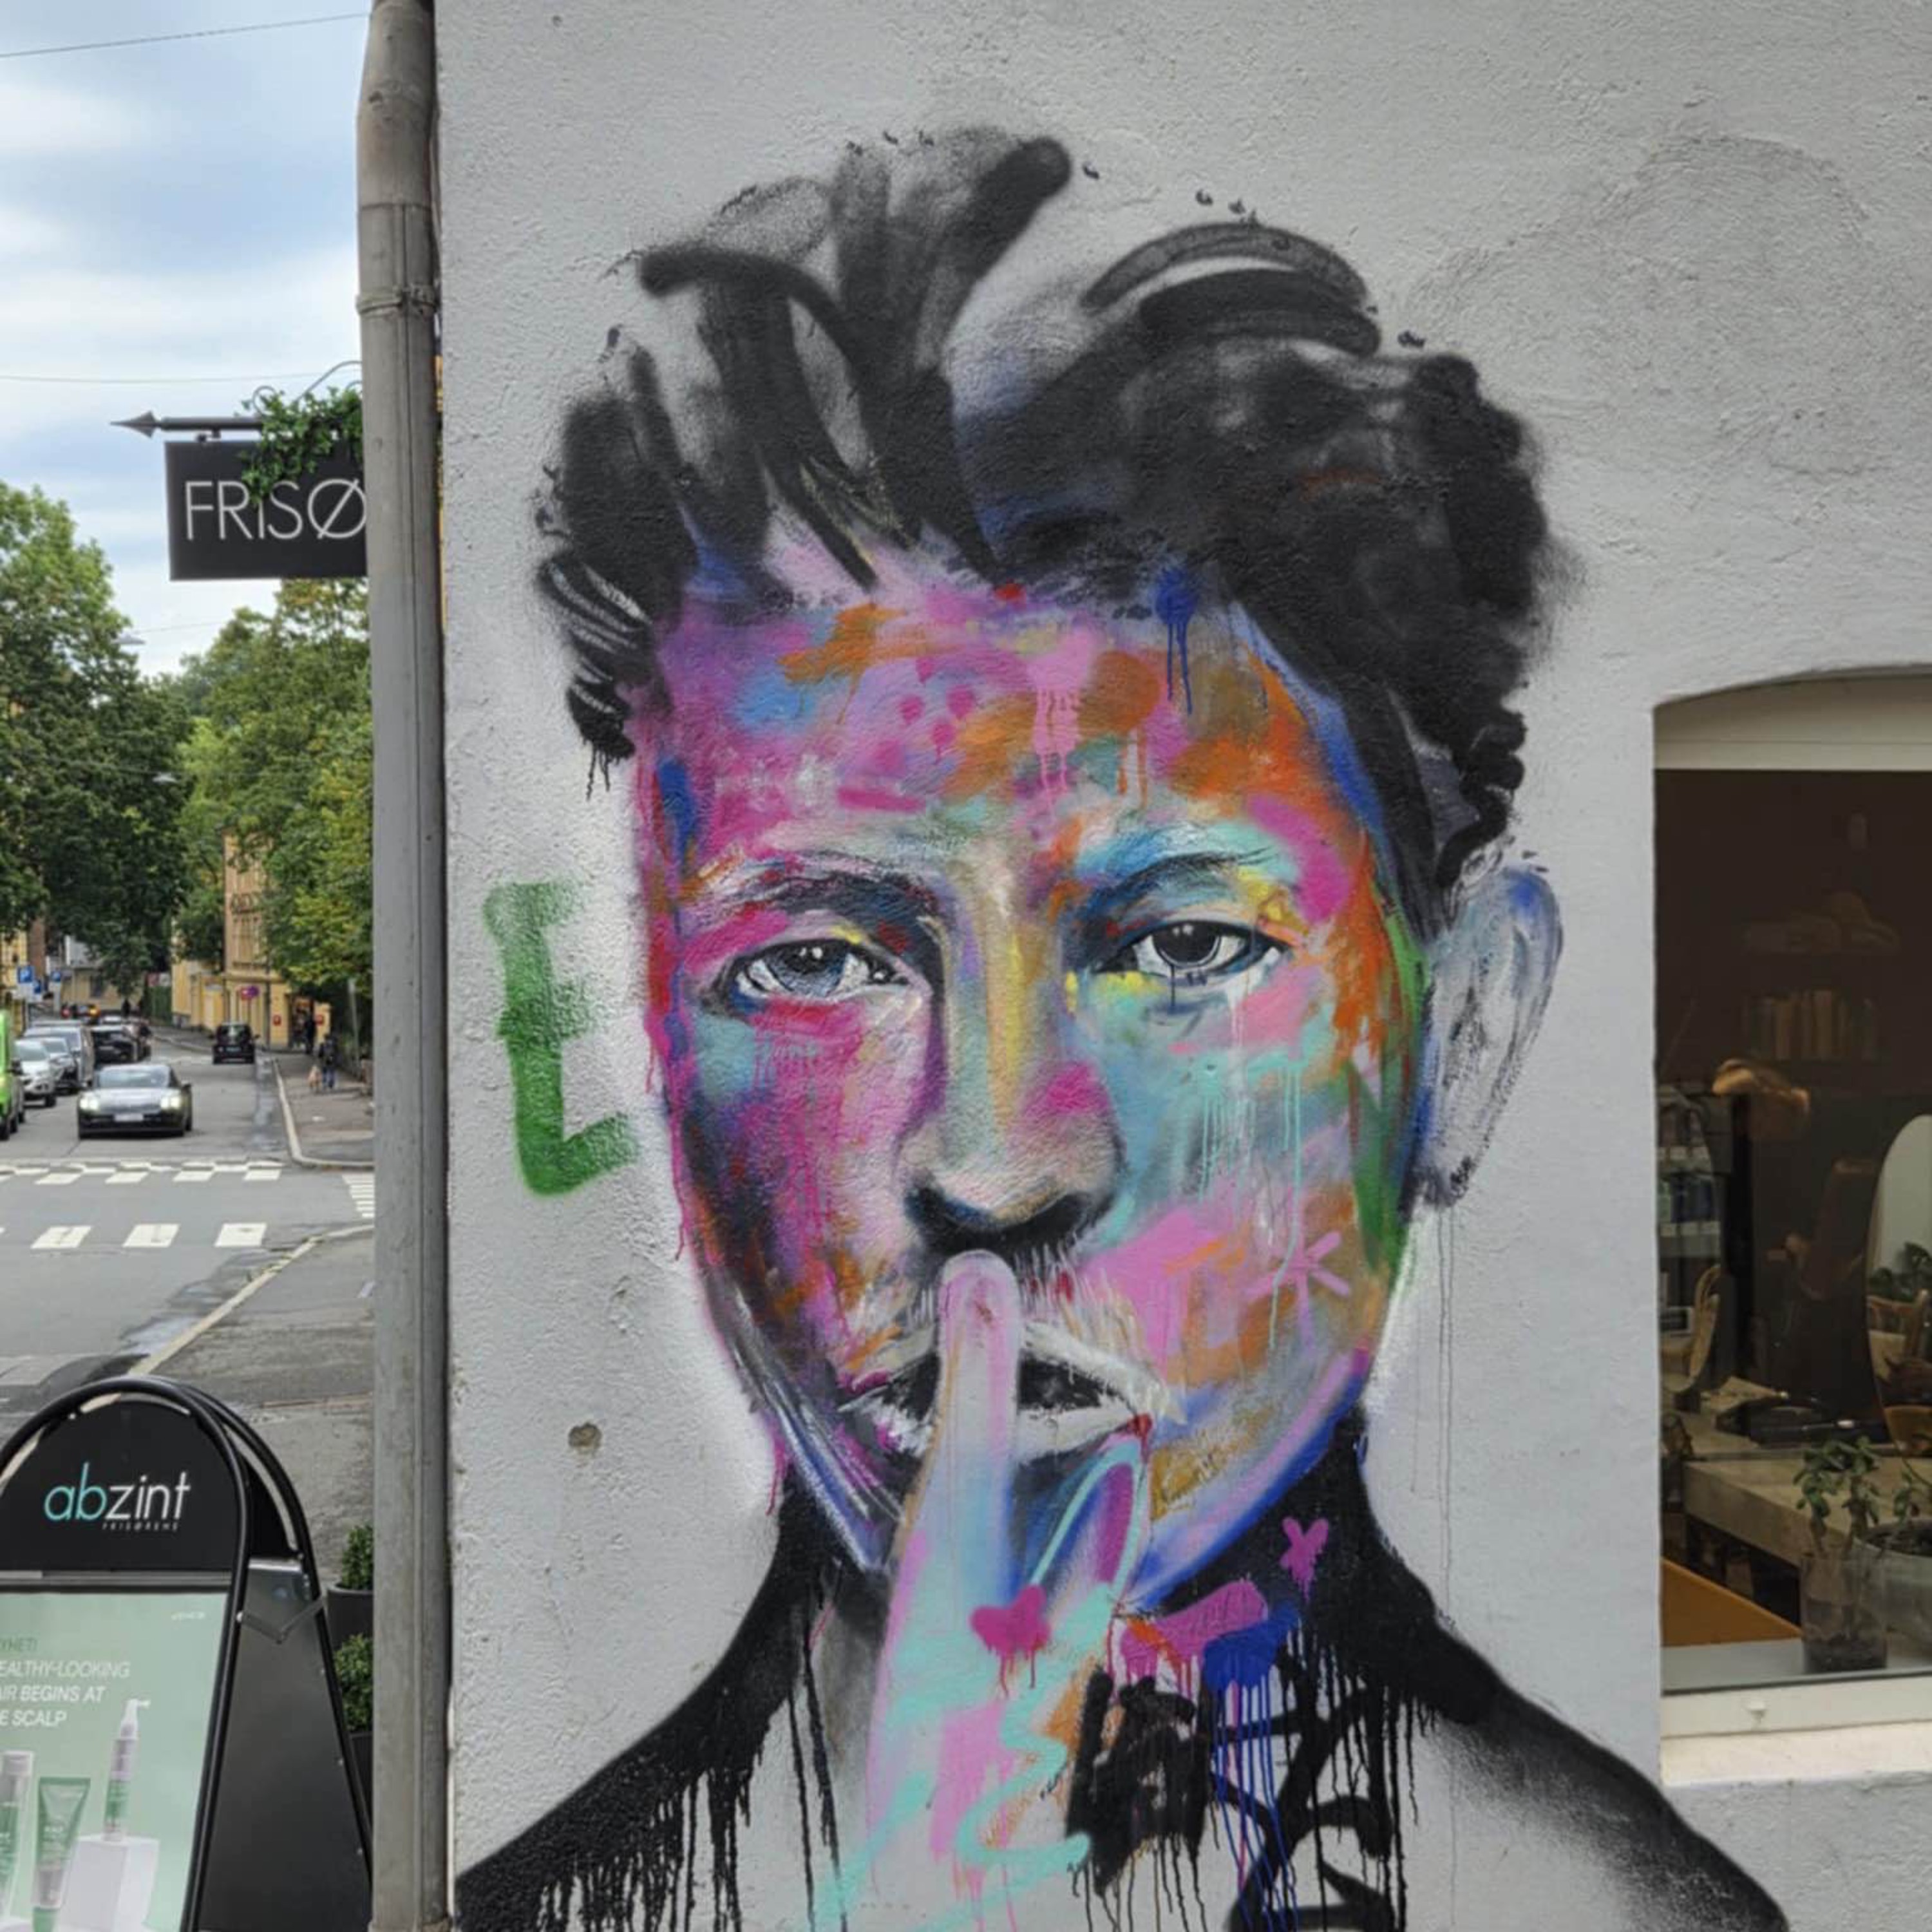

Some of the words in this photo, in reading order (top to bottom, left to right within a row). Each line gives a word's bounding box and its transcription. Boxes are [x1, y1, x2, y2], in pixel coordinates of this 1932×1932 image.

[185, 478, 367, 541] FRISØ
[44, 1461, 191, 1521] abzint
[20, 1685, 80, 1702] BEGINS
[82, 1685, 106, 1703] AT
[12, 1710, 67, 1727] SCALP
